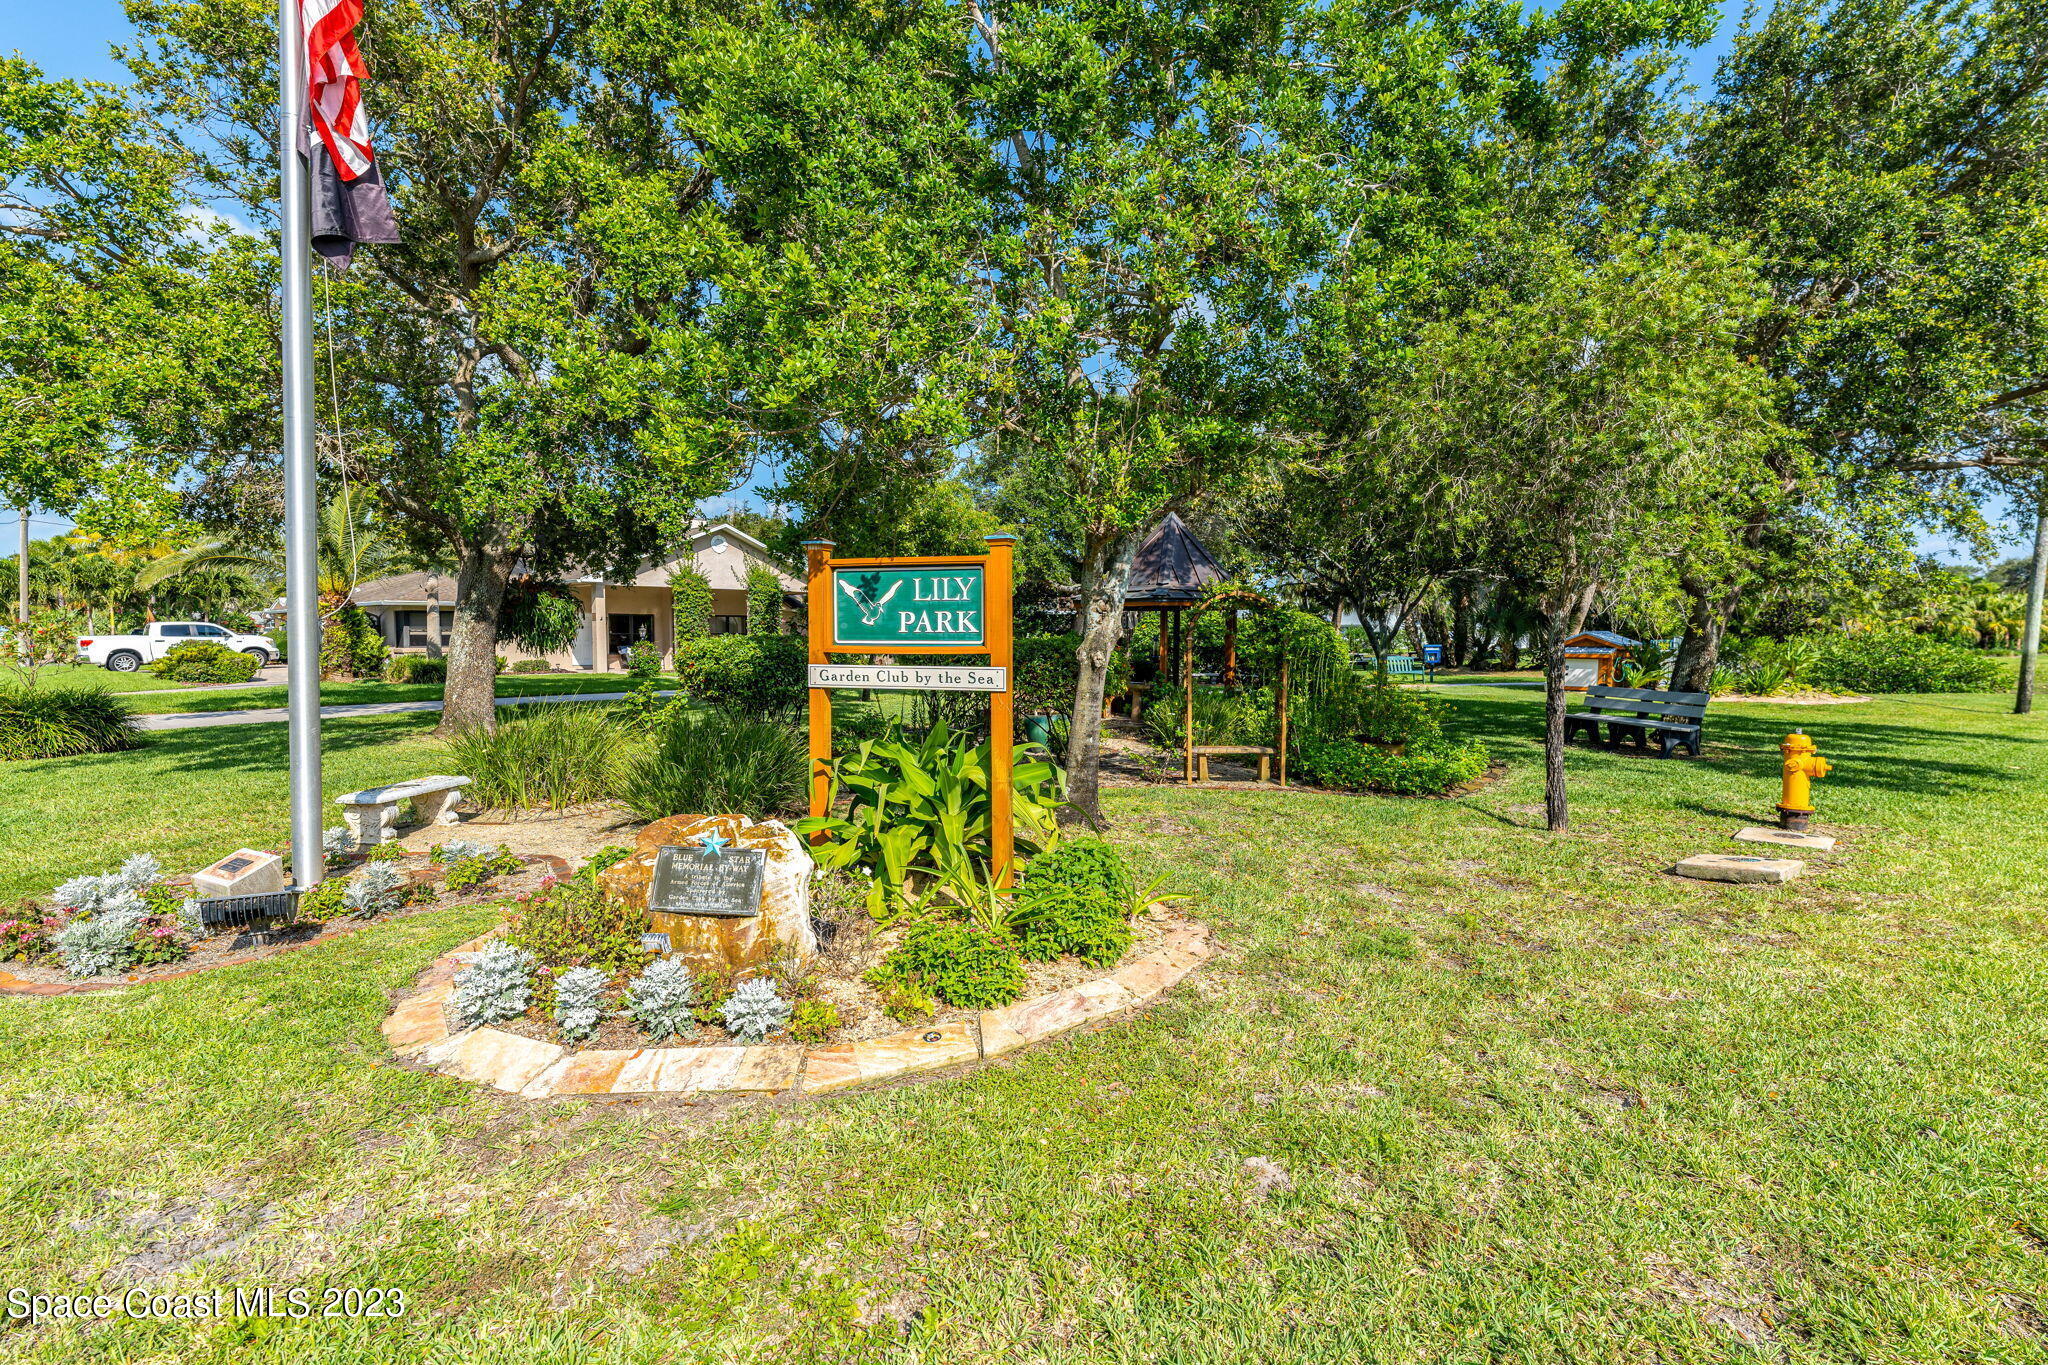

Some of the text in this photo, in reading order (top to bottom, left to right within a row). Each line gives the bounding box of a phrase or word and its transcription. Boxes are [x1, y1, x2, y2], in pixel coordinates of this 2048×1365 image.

[913, 577, 977, 601] LILY
[898, 610, 979, 633] PARK
[819, 669, 994, 685] Garden Club by the Sea
[672, 863, 713, 871] MEMORIAL
